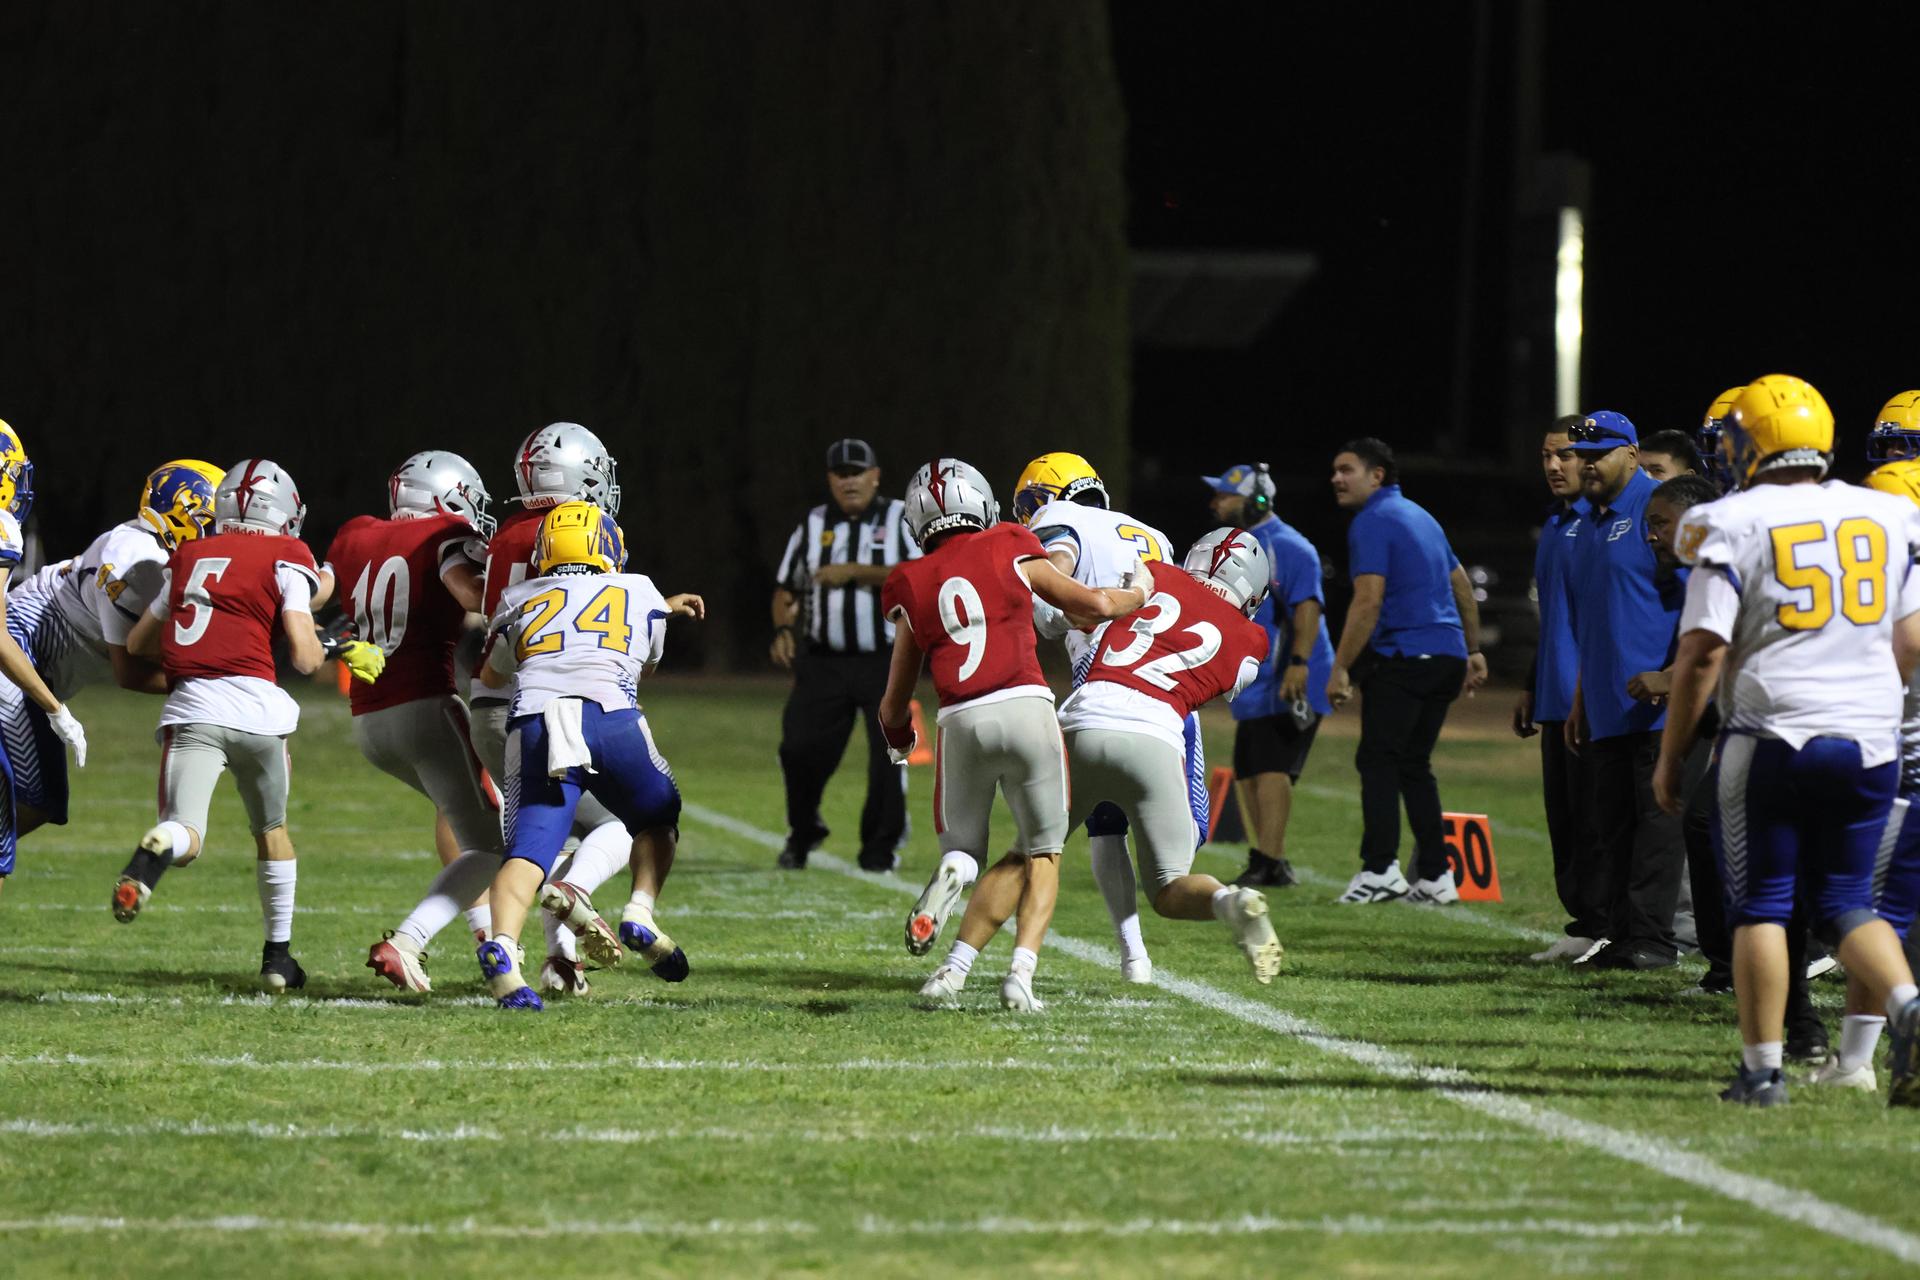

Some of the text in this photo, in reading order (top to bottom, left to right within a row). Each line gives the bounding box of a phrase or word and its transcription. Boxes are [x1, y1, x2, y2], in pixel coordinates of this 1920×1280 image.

[1607, 517, 1633, 541] P
[1769, 516, 1888, 631] 58
[175, 557, 232, 646] 5
[351, 555, 410, 656] 10
[515, 585, 632, 663] 24
[938, 576, 987, 682] 9
[1102, 591, 1222, 691] 32
[1441, 818, 1492, 890] 50
